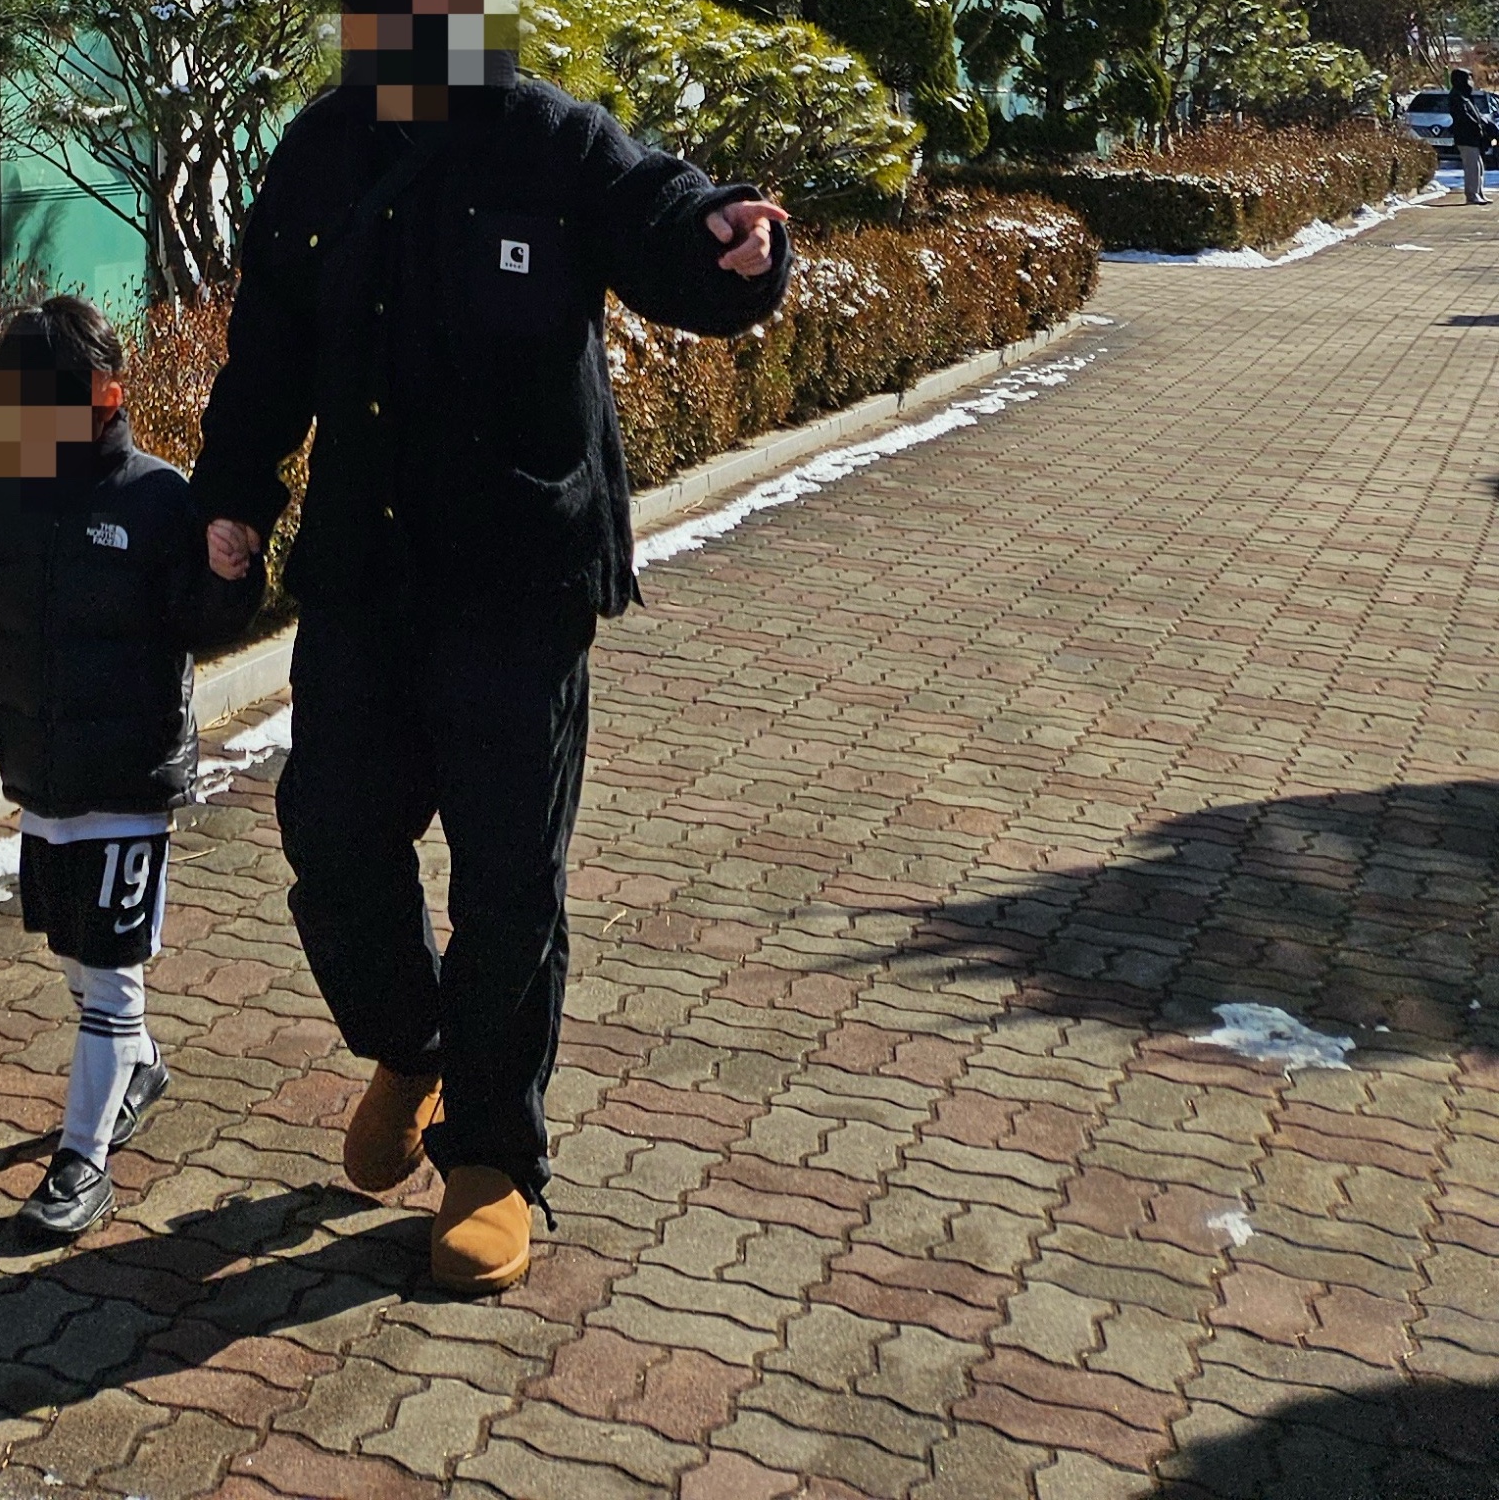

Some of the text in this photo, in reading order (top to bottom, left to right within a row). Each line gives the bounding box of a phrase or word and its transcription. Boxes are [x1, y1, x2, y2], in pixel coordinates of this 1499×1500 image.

[86, 527, 115, 539] NORTH
[100, 522, 115, 532] THE
[93, 535, 115, 547] FACE
[99, 842, 152, 909] 19
